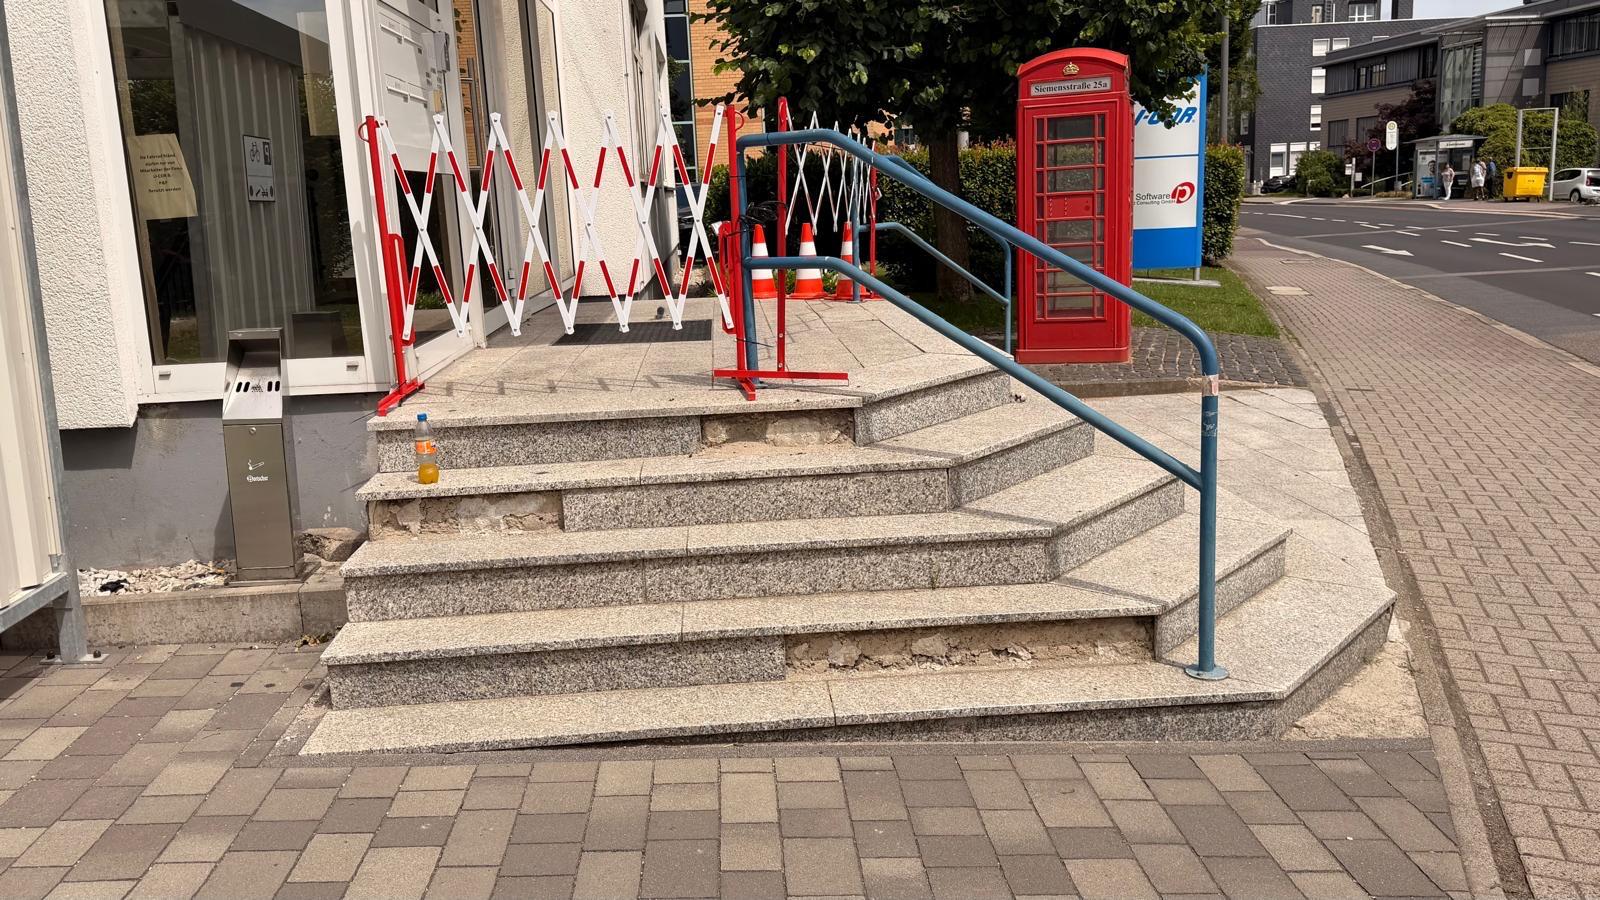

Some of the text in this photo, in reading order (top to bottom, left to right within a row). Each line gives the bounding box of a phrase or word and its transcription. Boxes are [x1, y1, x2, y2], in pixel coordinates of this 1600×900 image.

[1034, 81, 1108, 93] Siemensstraße 25a
[1135, 192, 1171, 201] Software
